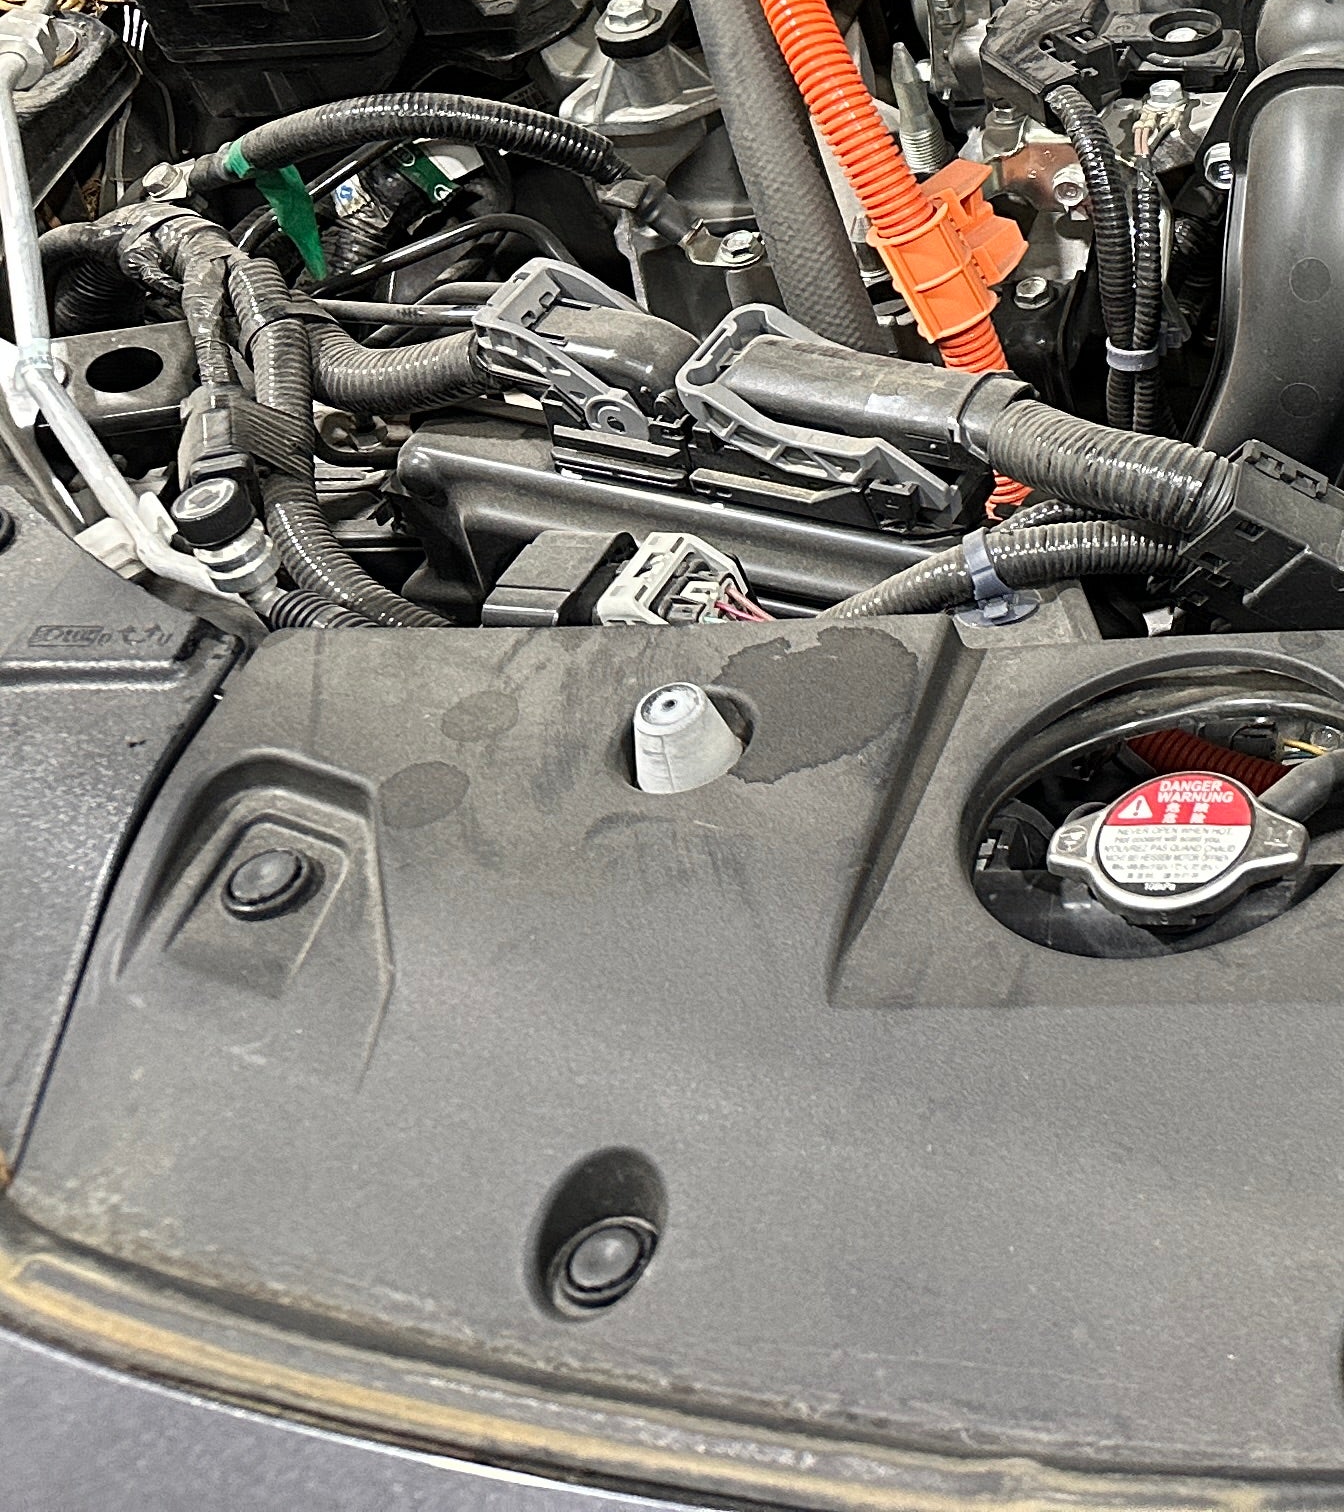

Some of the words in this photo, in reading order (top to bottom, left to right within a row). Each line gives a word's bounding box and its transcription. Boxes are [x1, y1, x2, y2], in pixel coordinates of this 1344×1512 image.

[1160, 780, 1223, 792] DANGER
[1157, 791, 1234, 803] WARNUNG
[1118, 827, 1149, 835] NEVER
[1170, 844, 1202, 852] QUAND
